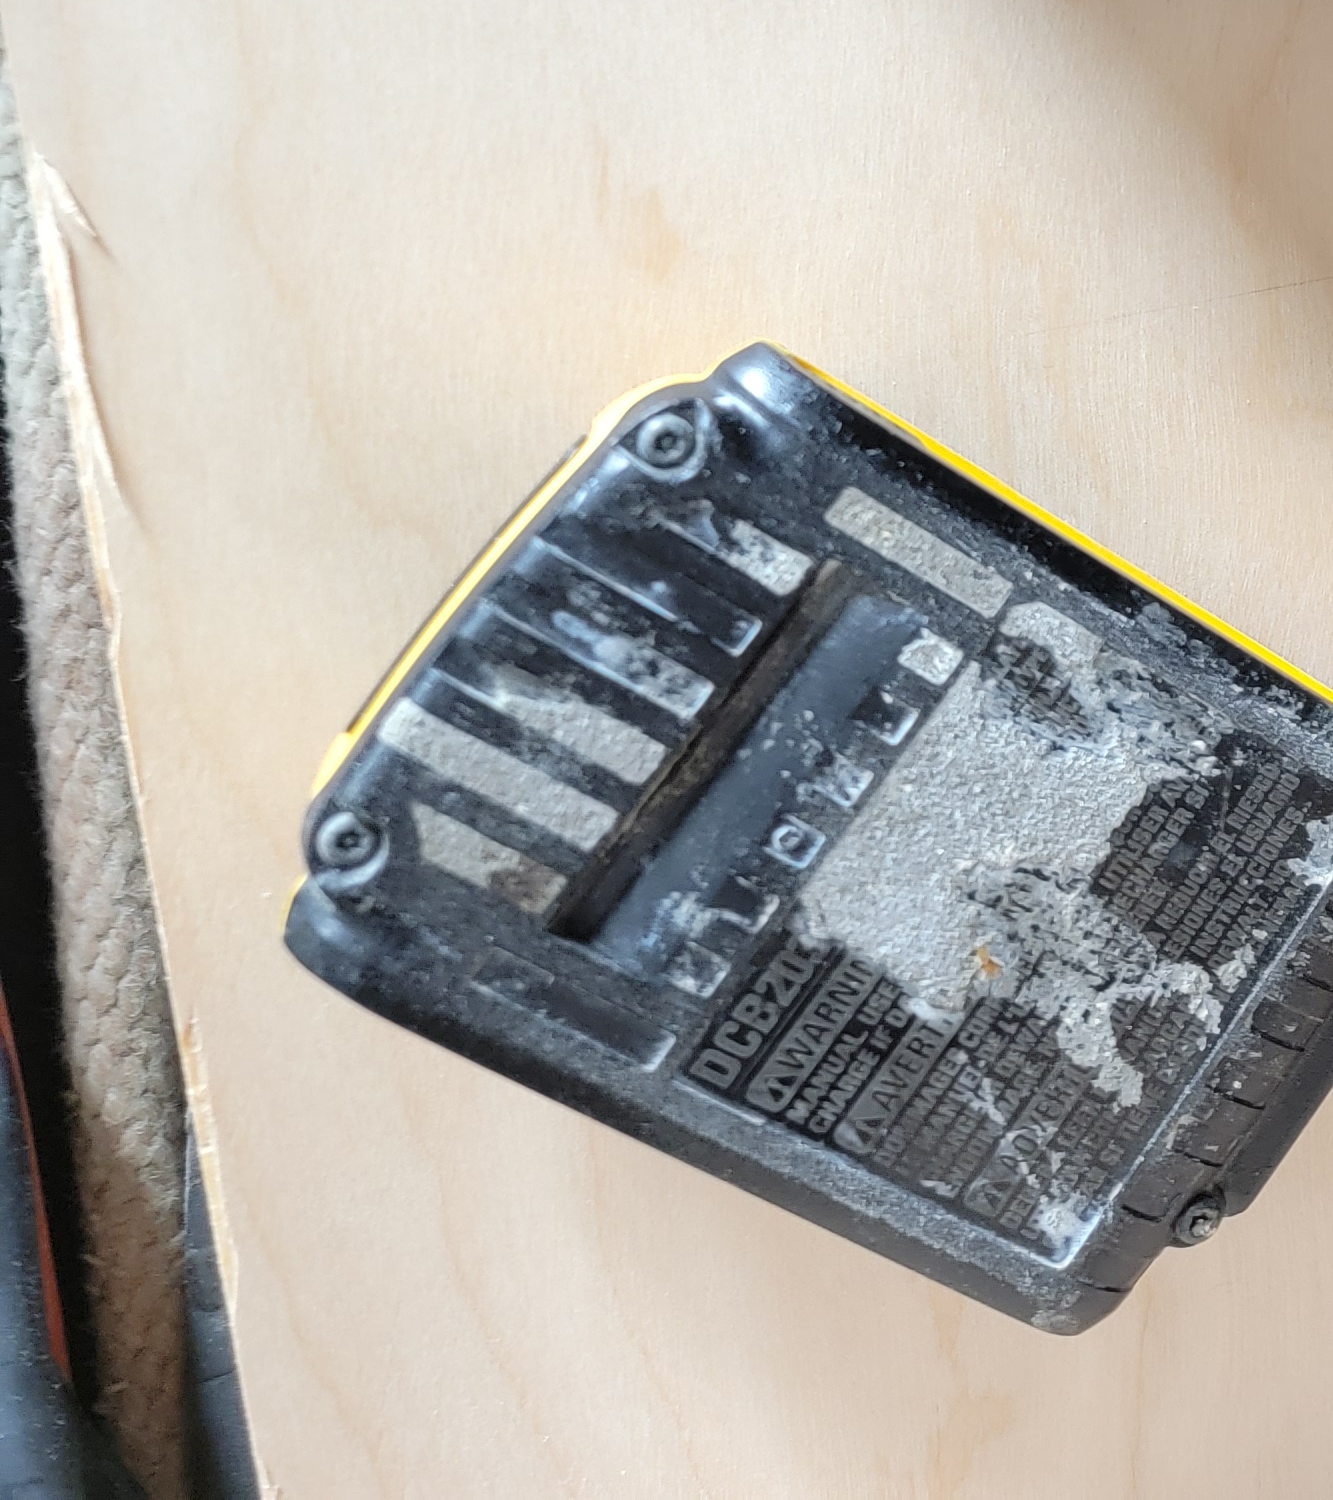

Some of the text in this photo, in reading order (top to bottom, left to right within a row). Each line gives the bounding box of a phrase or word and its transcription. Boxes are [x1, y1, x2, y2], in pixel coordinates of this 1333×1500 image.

[1223, 758, 1285, 832] RIESGO
[1233, 768, 1303, 854] USUARIO
[1096, 800, 1172, 893] UTILISER
[806, 1044, 883, 1138] CHARGE
[869, 1022, 899, 1054] IF
